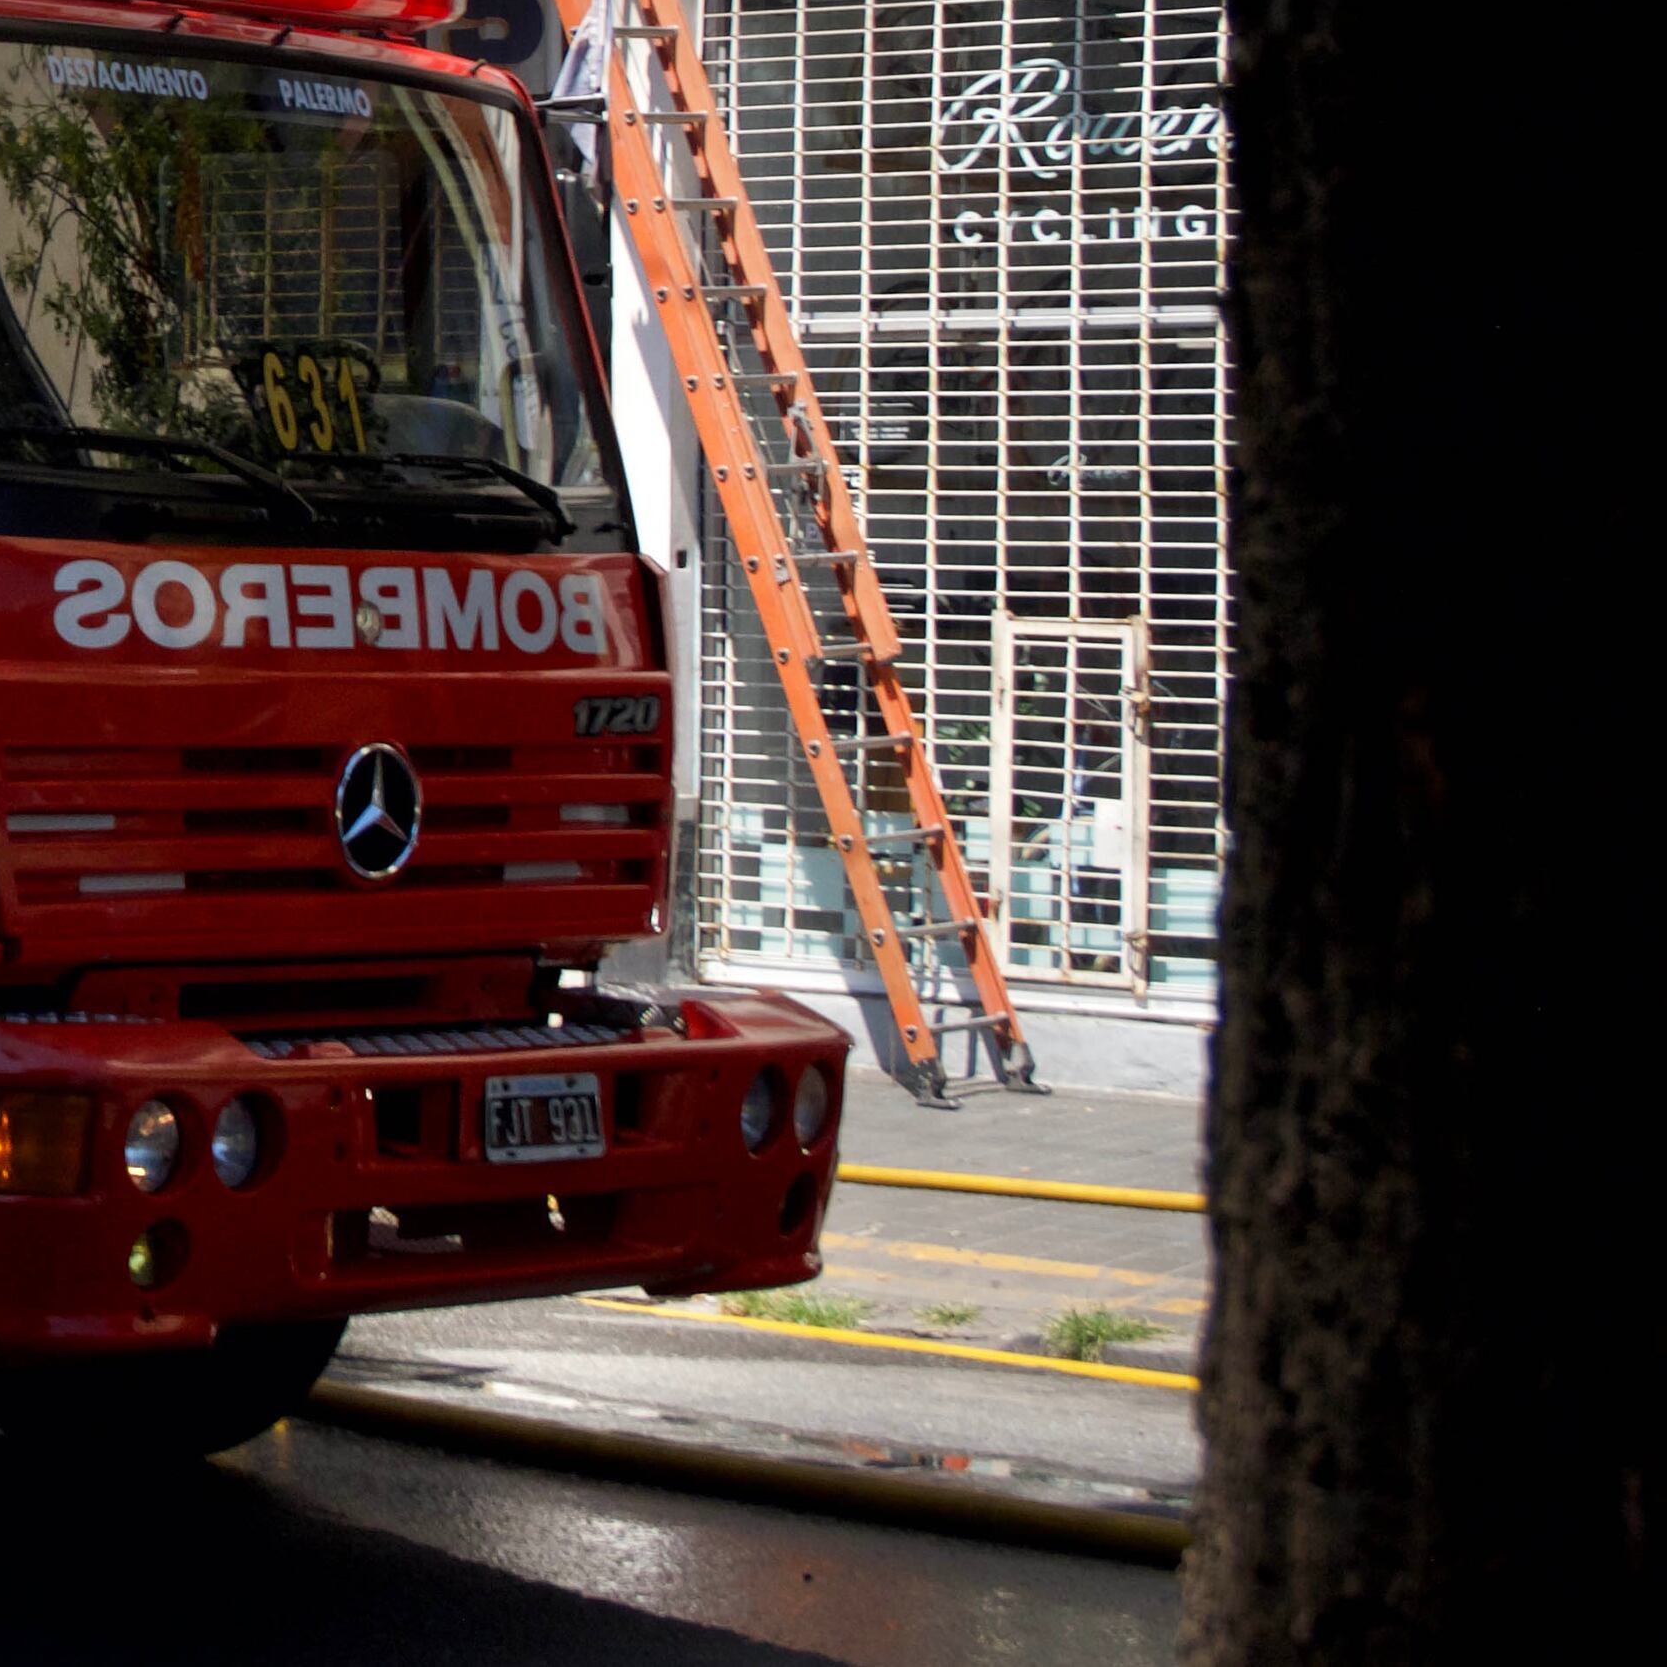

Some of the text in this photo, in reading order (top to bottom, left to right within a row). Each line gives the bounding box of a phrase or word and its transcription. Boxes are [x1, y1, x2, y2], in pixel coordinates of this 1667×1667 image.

[46, 54, 373, 118] DESTACAMENTO PALERMO
[953, 204, 1209, 244] CYCLING
[263, 352, 367, 453] 631
[572, 695, 660, 735] 1720
[548, 1095, 599, 1144] 931
